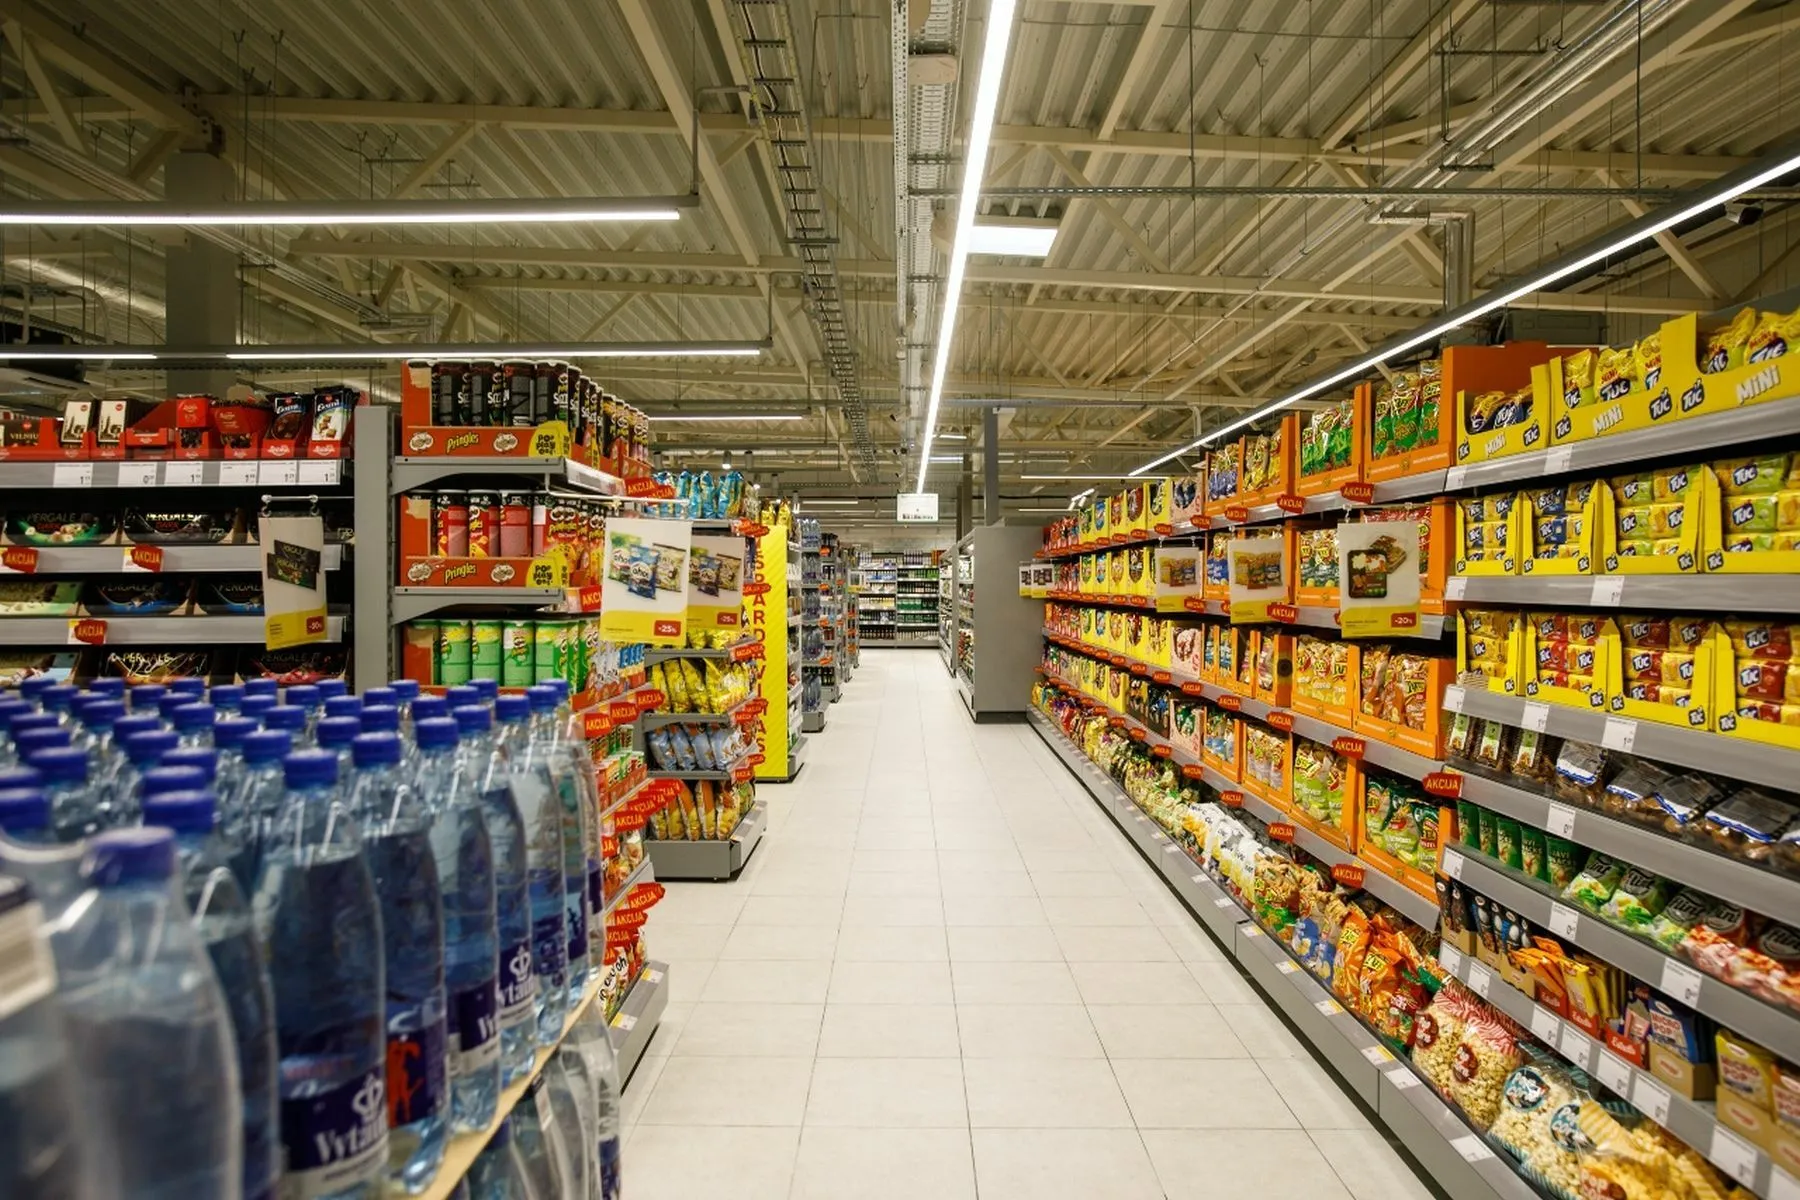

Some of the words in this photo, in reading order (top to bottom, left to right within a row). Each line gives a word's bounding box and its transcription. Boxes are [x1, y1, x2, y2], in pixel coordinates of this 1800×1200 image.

[1601, 380, 1630, 401] TUC
[1683, 388, 1704, 411] TUC
[1651, 398, 1671, 418] TUC
[1557, 420, 1571, 437] TUC
[10, 432, 39, 441] VILNIU
[446, 431, 480, 454] Pringles
[1524, 427, 1540, 445] TUC
[1670, 473, 1687, 492] TUC
[1734, 466, 1757, 485] TUC
[627, 481, 656, 495] AKCIJA
[1343, 486, 1371, 498] AKCIJA
[1624, 483, 1638, 497] TUC
[1279, 498, 1303, 509] AKCIJA
[1733, 506, 1754, 524] TUC
[1623, 517, 1637, 531] TUC
[5, 552, 36, 565] AKCIJA
[134, 550, 161, 564] AKCIJA
[1708, 555, 1723, 570] TUC
[444, 562, 478, 585] Pringles
[1271, 608, 1296, 619] AKCIJA
[1394, 616, 1413, 625] -20%
[78, 623, 104, 637] AKCIJA
[1631, 624, 1649, 638] TUC
[1681, 626, 1697, 642] TUC
[1746, 629, 1769, 648] TUC
[1579, 654, 1594, 667] TUC
[1633, 655, 1651, 671] TUC
[1741, 669, 1761, 686] TUC
[638, 692, 663, 705] AKCIJA
[1612, 698, 1625, 711] TUC
[612, 706, 637, 718] AKCIJA
[1690, 711, 1704, 725] TUC
[586, 718, 611, 731] AKCIJA
[1268, 715, 1291, 727] AKCIJA
[1720, 718, 1736, 732] TUC
[1334, 741, 1363, 754] AKCIJA
[1425, 778, 1459, 792] AKCIJA
[616, 815, 644, 828] AKCIJA
[1269, 826, 1293, 838] AKCIJA
[1333, 868, 1363, 882] AKCIJA
[630, 889, 657, 909] AKCIJA
[1674, 896, 1701, 917] flint
[616, 911, 644, 925] AKCIJA
[606, 930, 631, 943] KCIJA
[1654, 1023, 1674, 1036] POP
